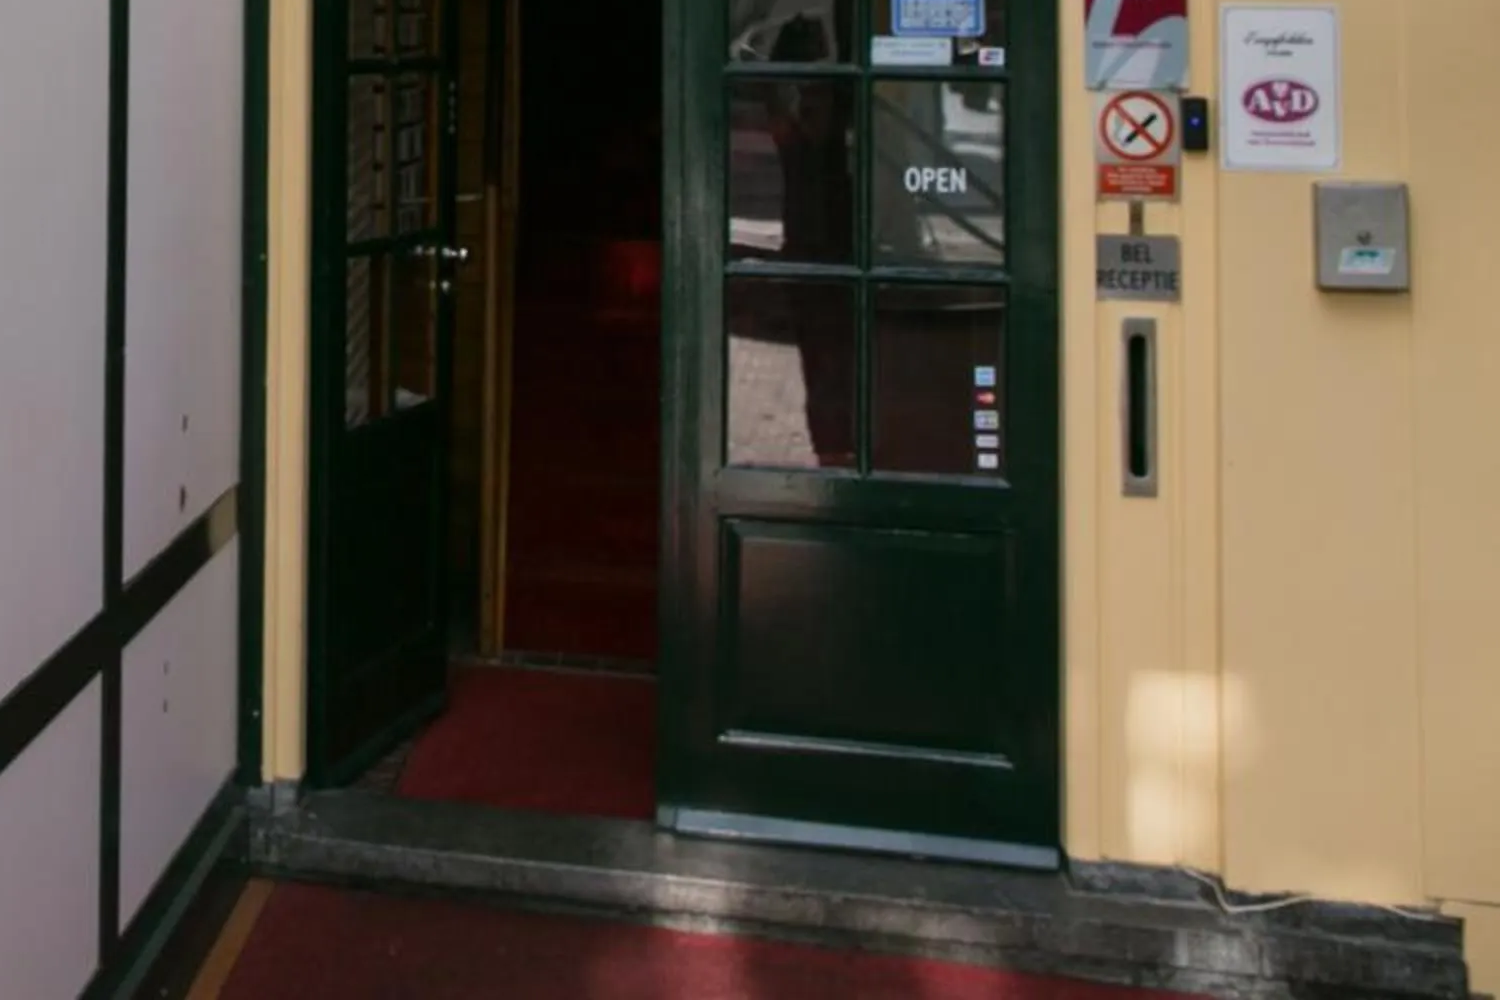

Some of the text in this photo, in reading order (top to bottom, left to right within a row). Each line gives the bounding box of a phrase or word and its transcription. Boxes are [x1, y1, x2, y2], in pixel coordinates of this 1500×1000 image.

[904, 167, 967, 193] OPEN
[1121, 243, 1153, 265] BEL
[1097, 267, 1178, 291] RECEPTIE
